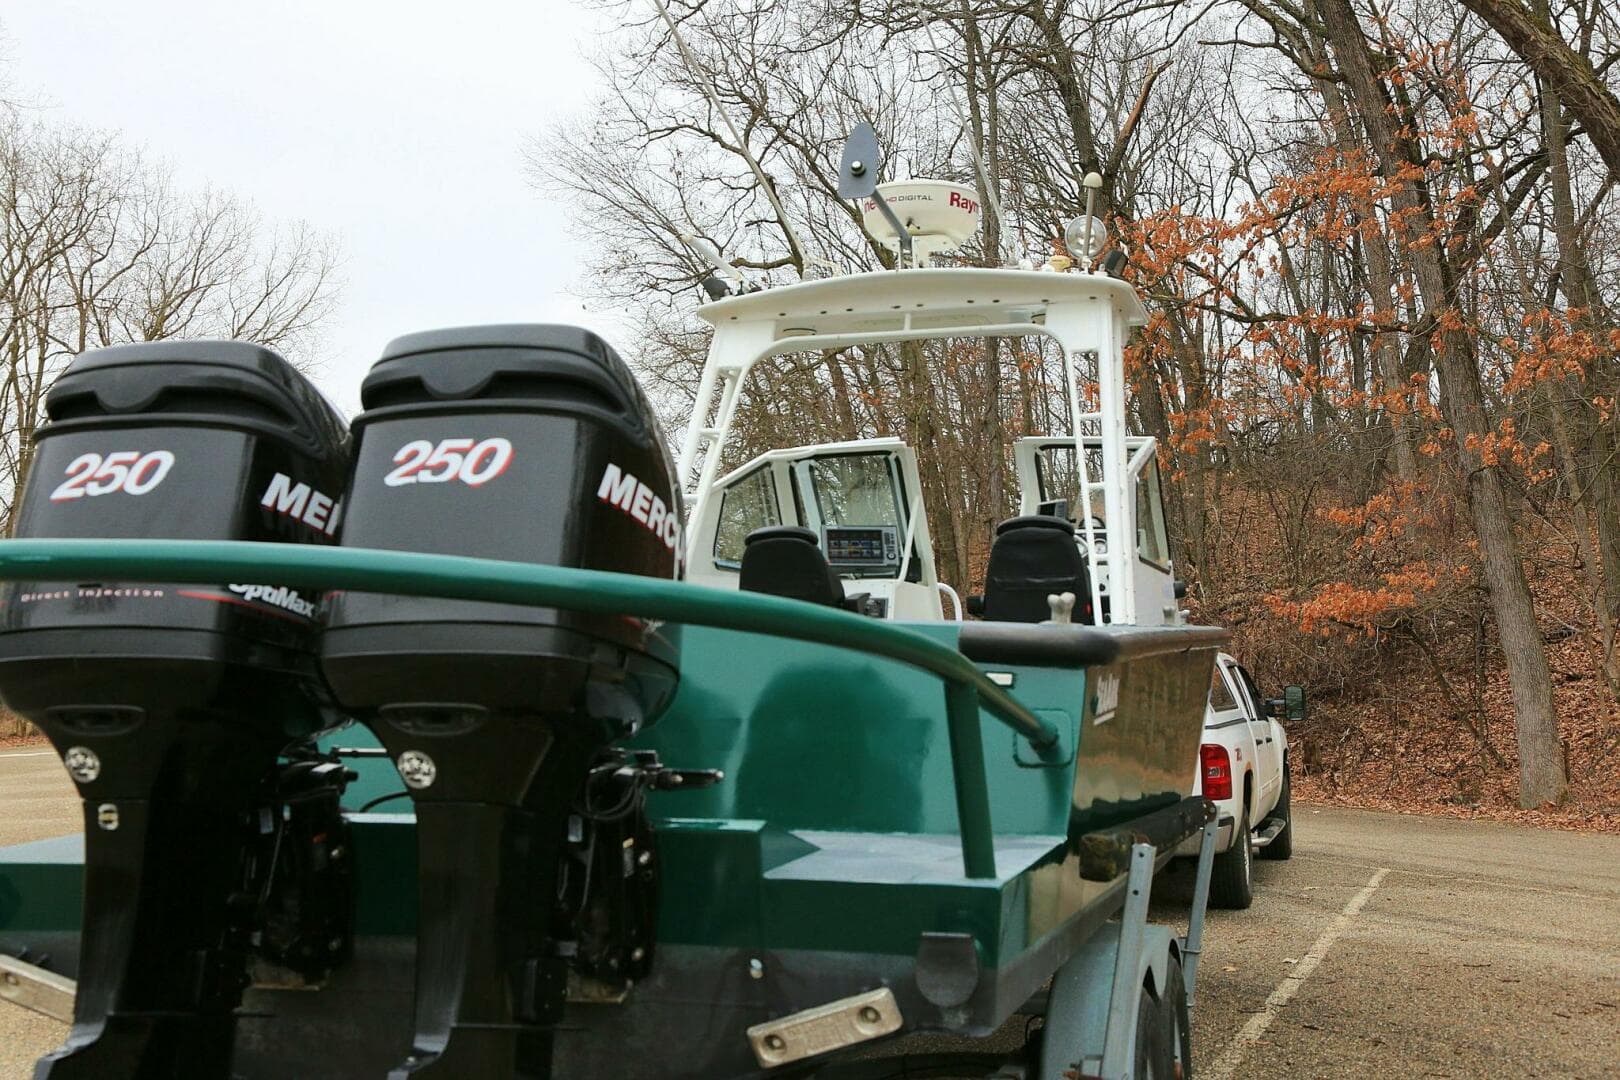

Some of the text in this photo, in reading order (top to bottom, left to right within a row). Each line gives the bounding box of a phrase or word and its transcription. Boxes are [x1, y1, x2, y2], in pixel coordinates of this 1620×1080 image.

[898, 194, 934, 202] DIGITAL
[50, 450, 175, 503] 250
[384, 437, 514, 487] 250
